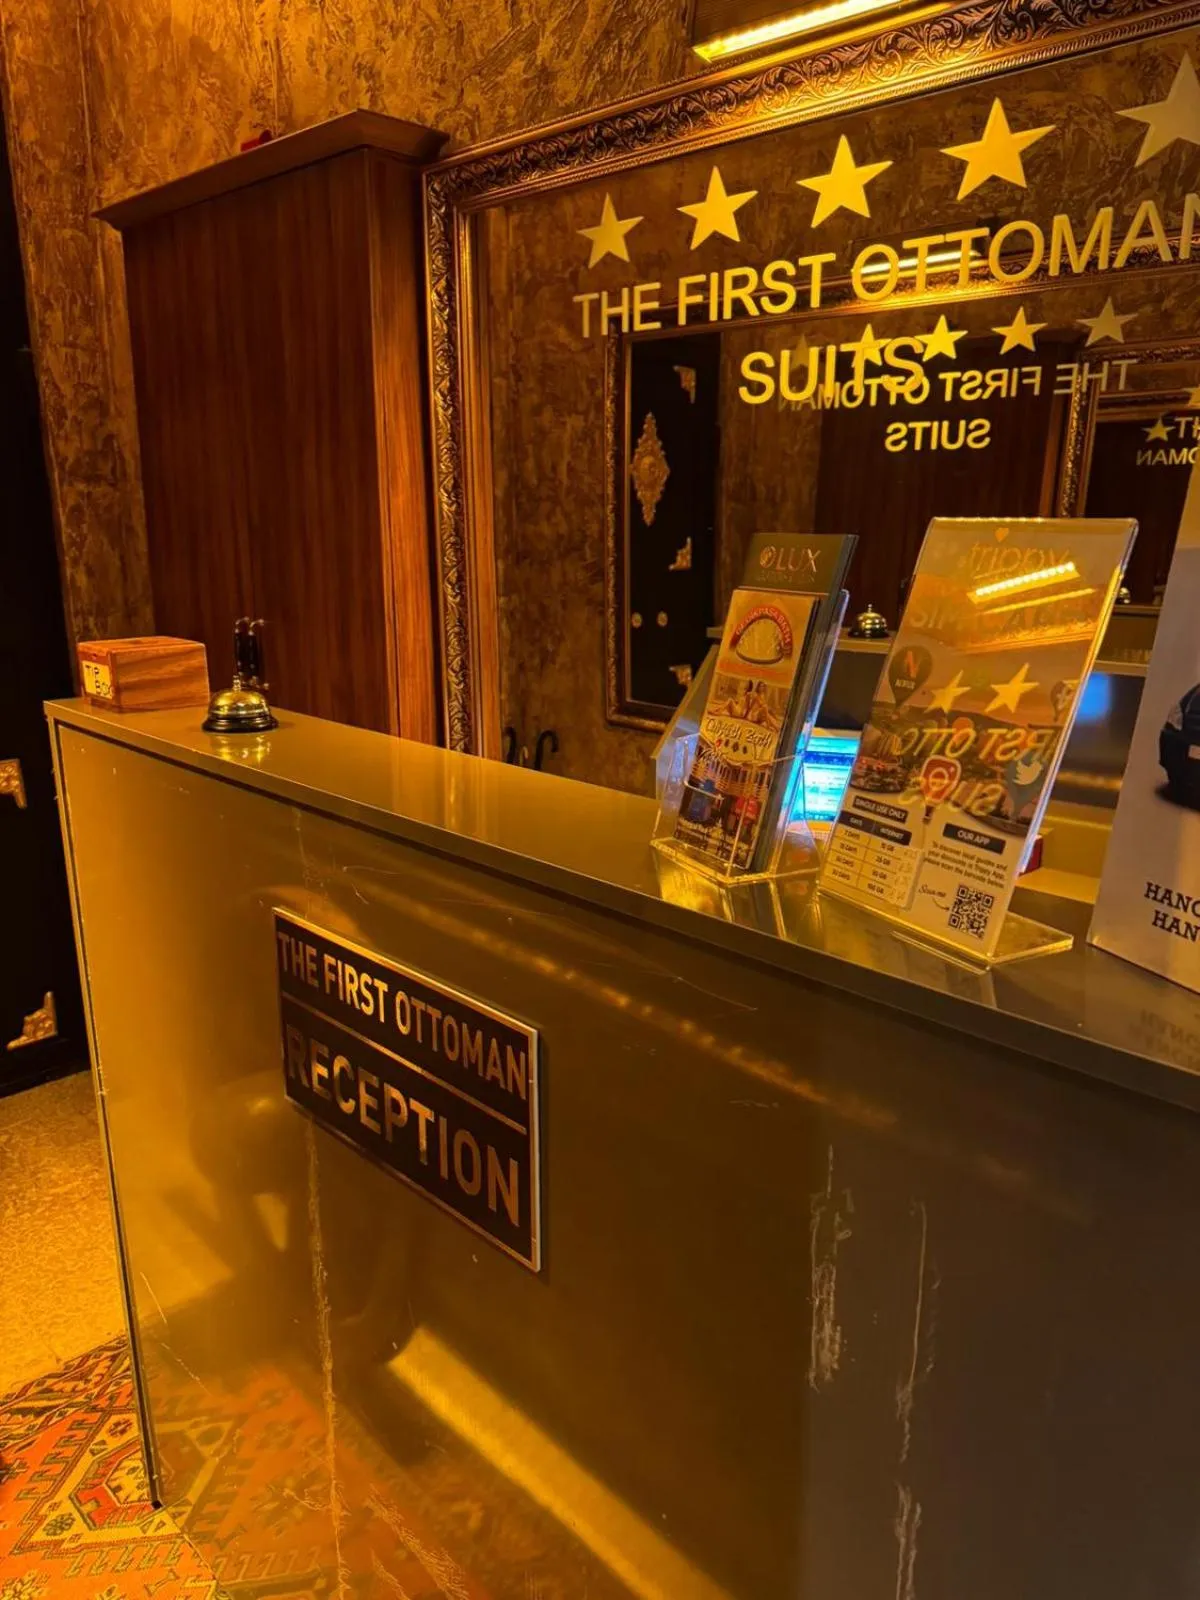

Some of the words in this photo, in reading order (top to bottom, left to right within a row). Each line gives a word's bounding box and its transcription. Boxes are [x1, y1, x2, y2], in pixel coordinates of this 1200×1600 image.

[572, 281, 662, 338] THE
[677, 252, 837, 326] FIRST
[738, 336, 925, 404] SUITS
[888, 807, 906, 820] ONLY
[957, 829, 974, 840] OUR
[974, 835, 990, 846] APP
[277, 931, 320, 989] THE
[322, 952, 389, 1023] FIRST
[395, 990, 527, 1101] OTTOMAN
[285, 1022, 520, 1228] RECEPTION
